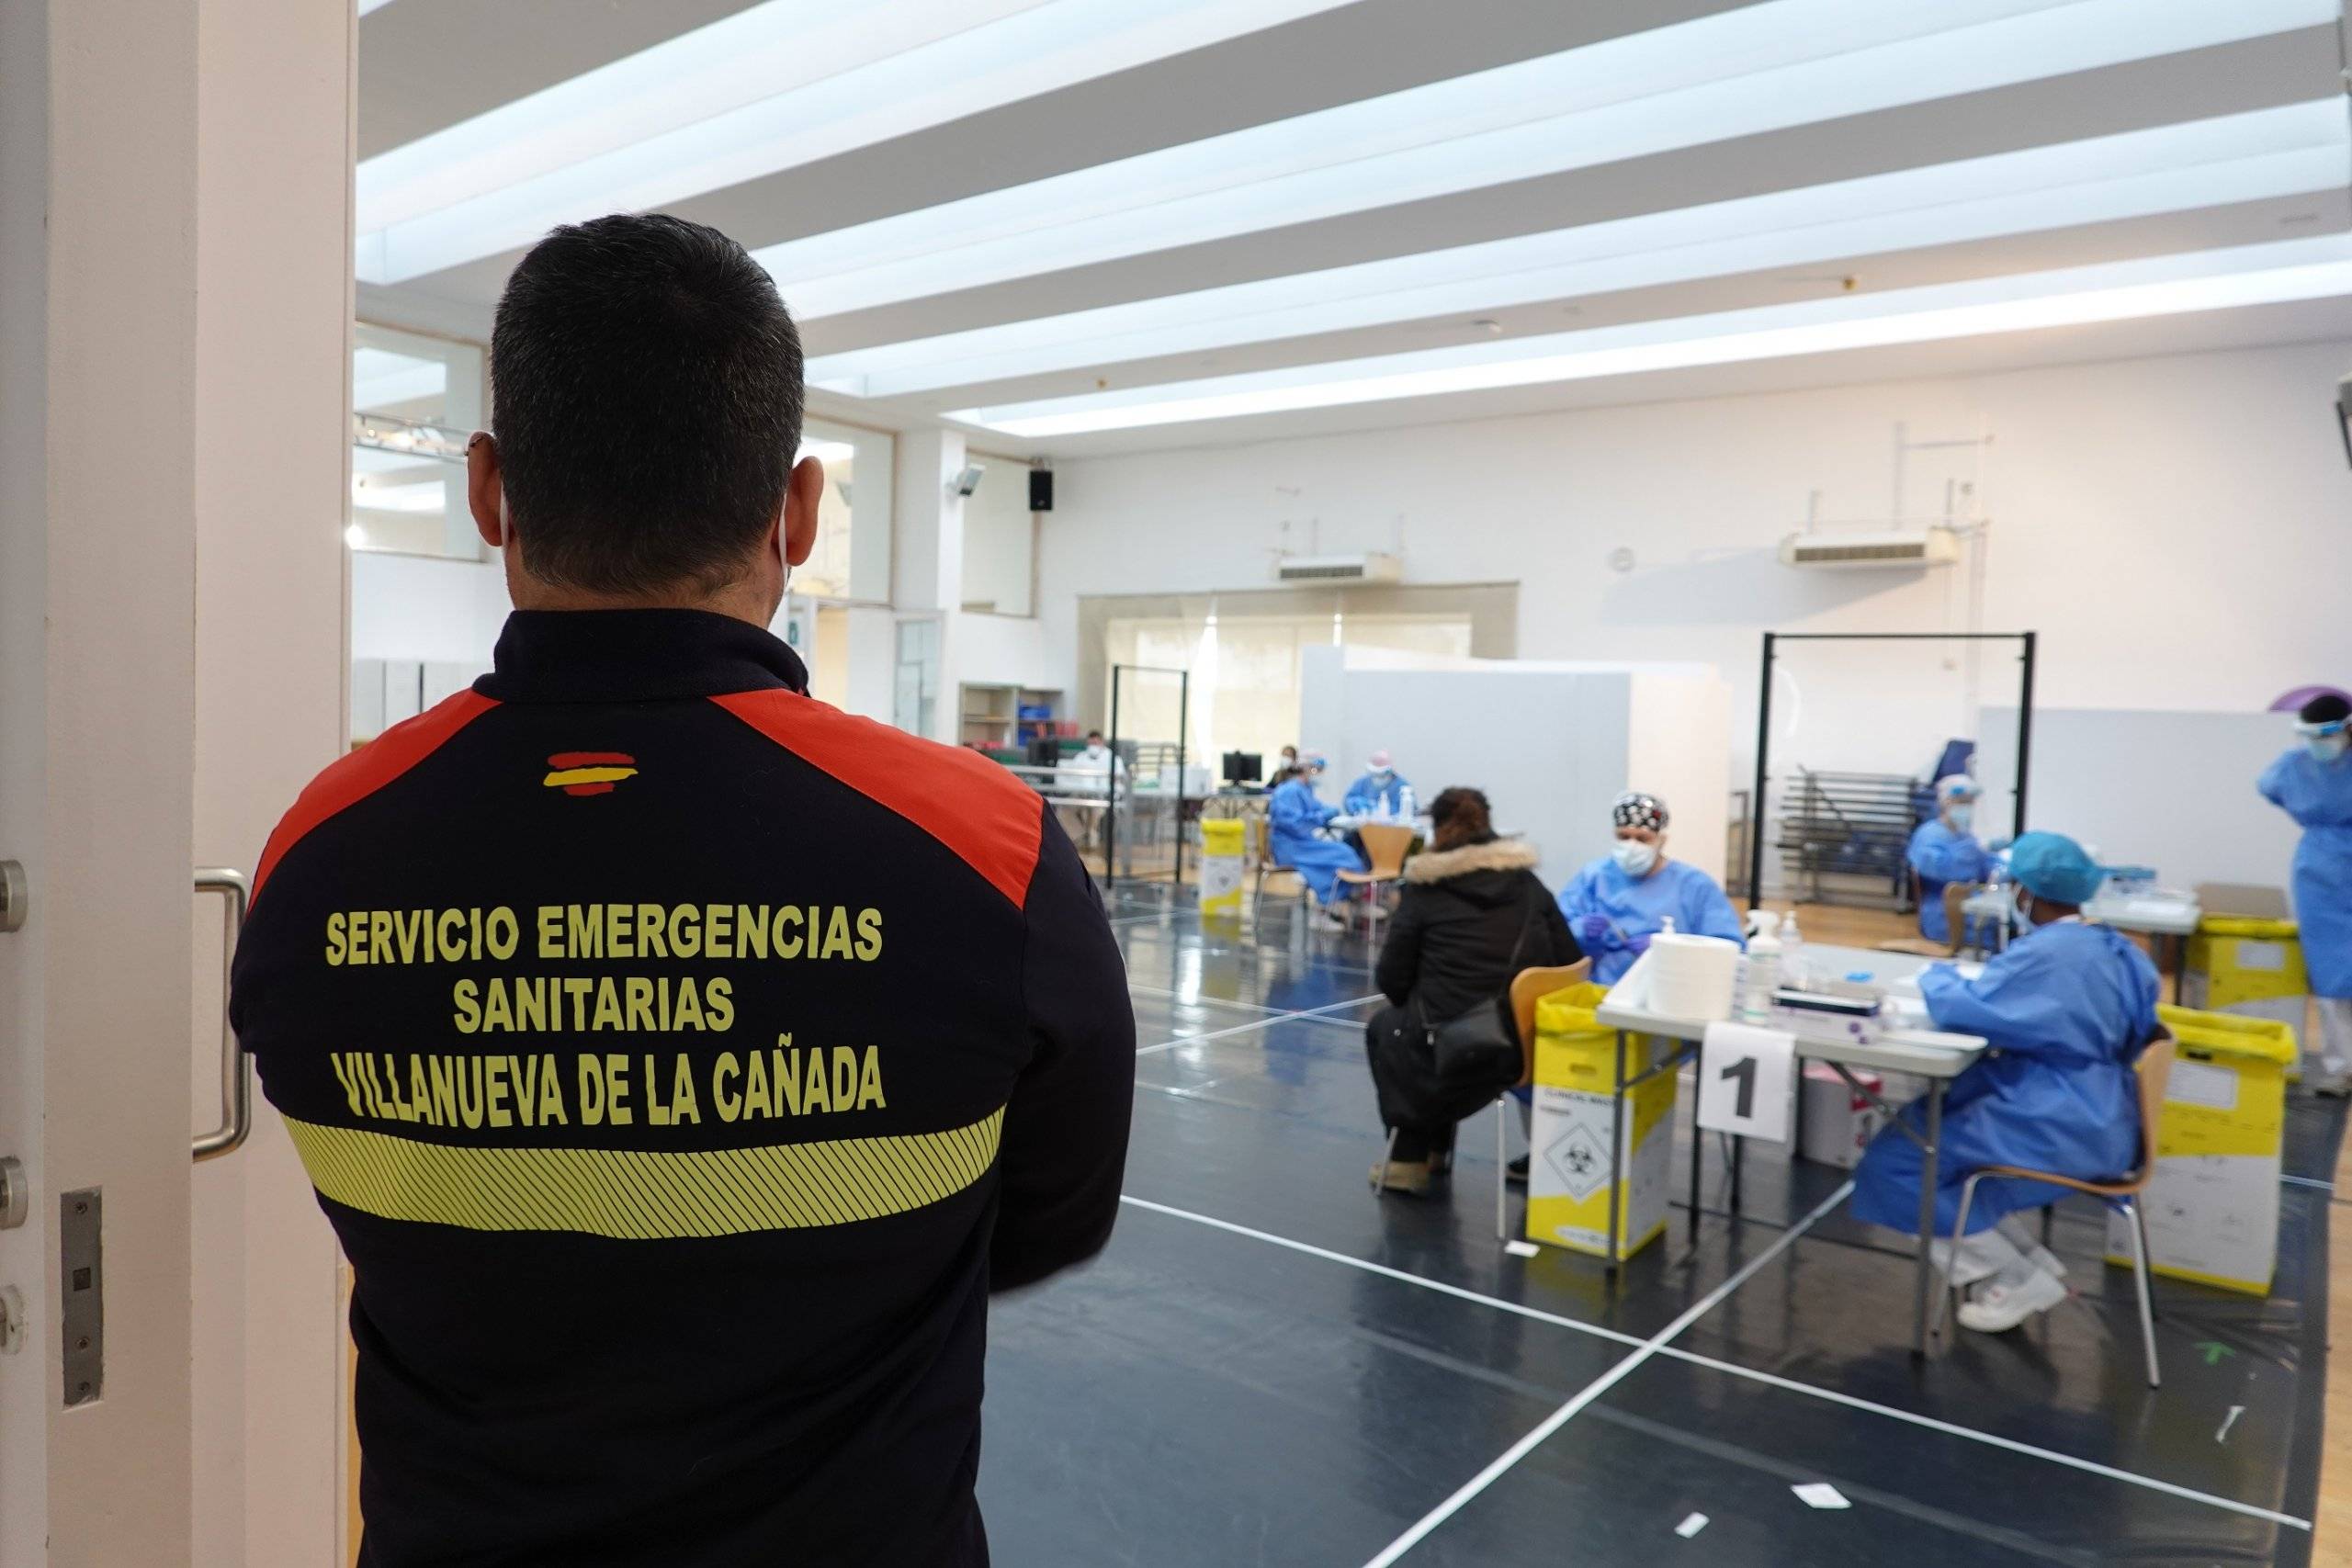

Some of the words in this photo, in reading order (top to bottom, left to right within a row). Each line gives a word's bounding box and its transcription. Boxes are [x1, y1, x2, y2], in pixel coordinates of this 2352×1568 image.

[325, 906, 520, 966] SERVICIO
[537, 903, 883, 962] EMERGENCIAS
[453, 976, 735, 1034] SANITARIAS
[330, 1052, 569, 1129] VILLANUEVA
[578, 1053, 633, 1125] DE
[644, 1053, 701, 1125] LA
[712, 1032, 887, 1122] CAÑADA
[1720, 1056, 1757, 1119] 1
